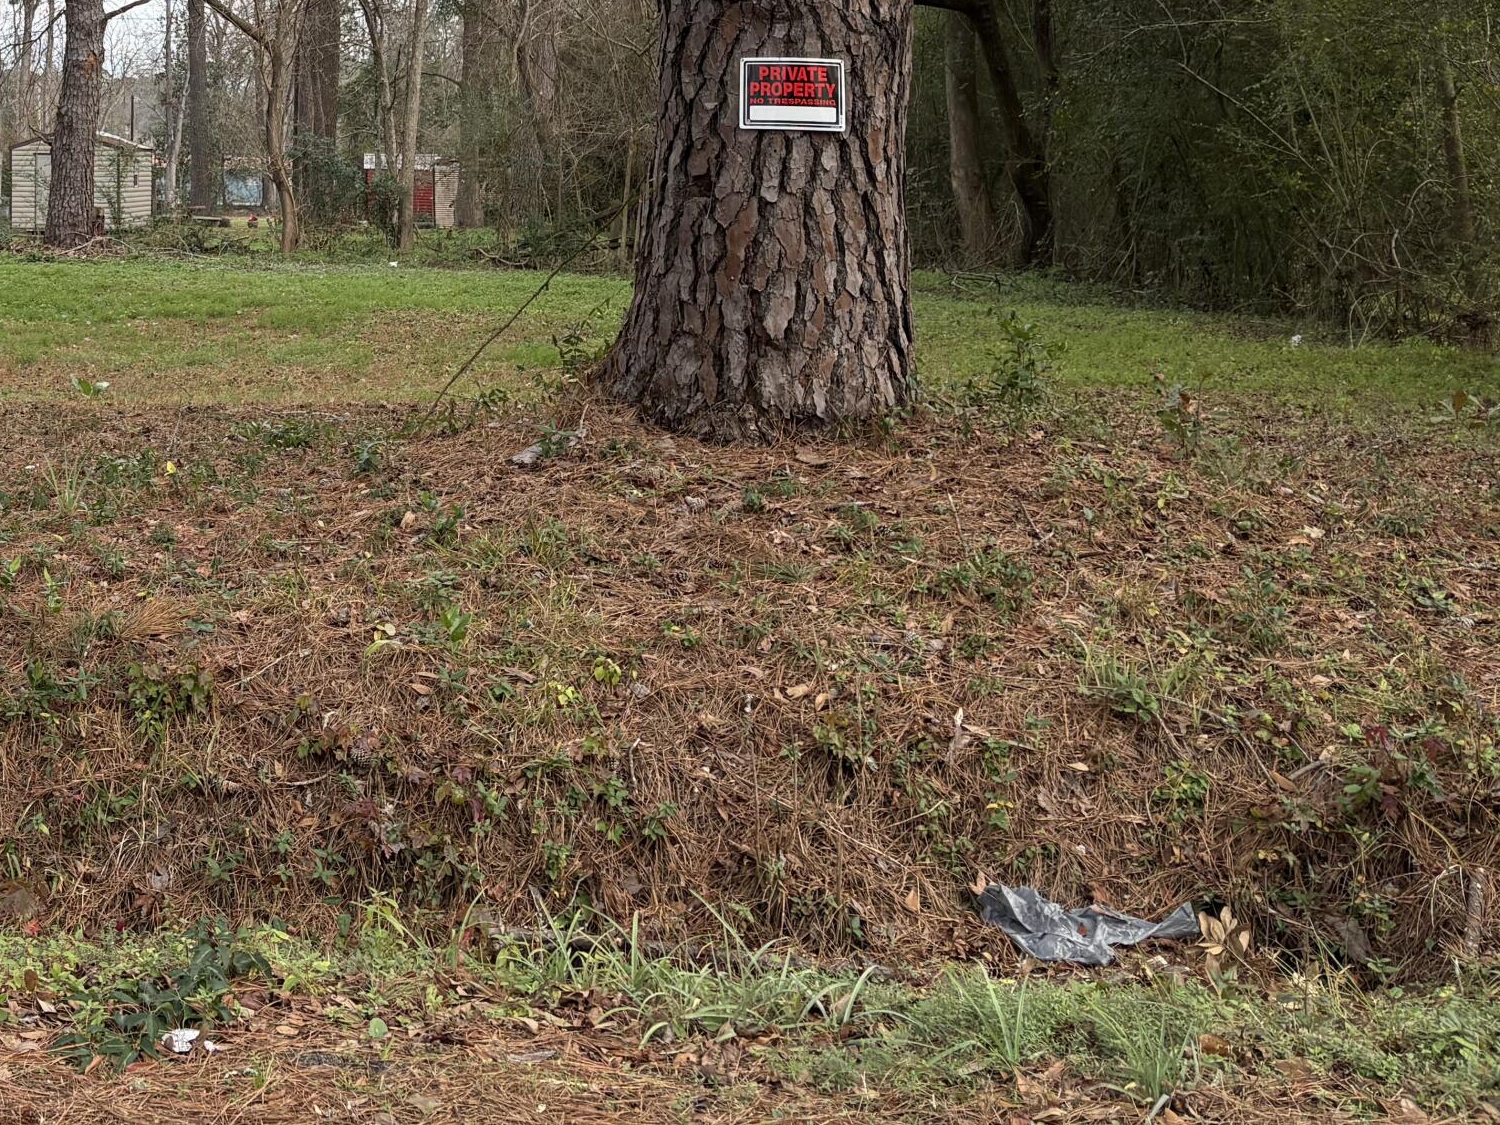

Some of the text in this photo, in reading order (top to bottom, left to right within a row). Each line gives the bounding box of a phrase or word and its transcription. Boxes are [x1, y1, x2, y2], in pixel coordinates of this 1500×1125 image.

[759, 66, 828, 82] PRIVATE
[750, 82, 836, 97] PROPERTY
[769, 98, 836, 106] TRESPASSING
